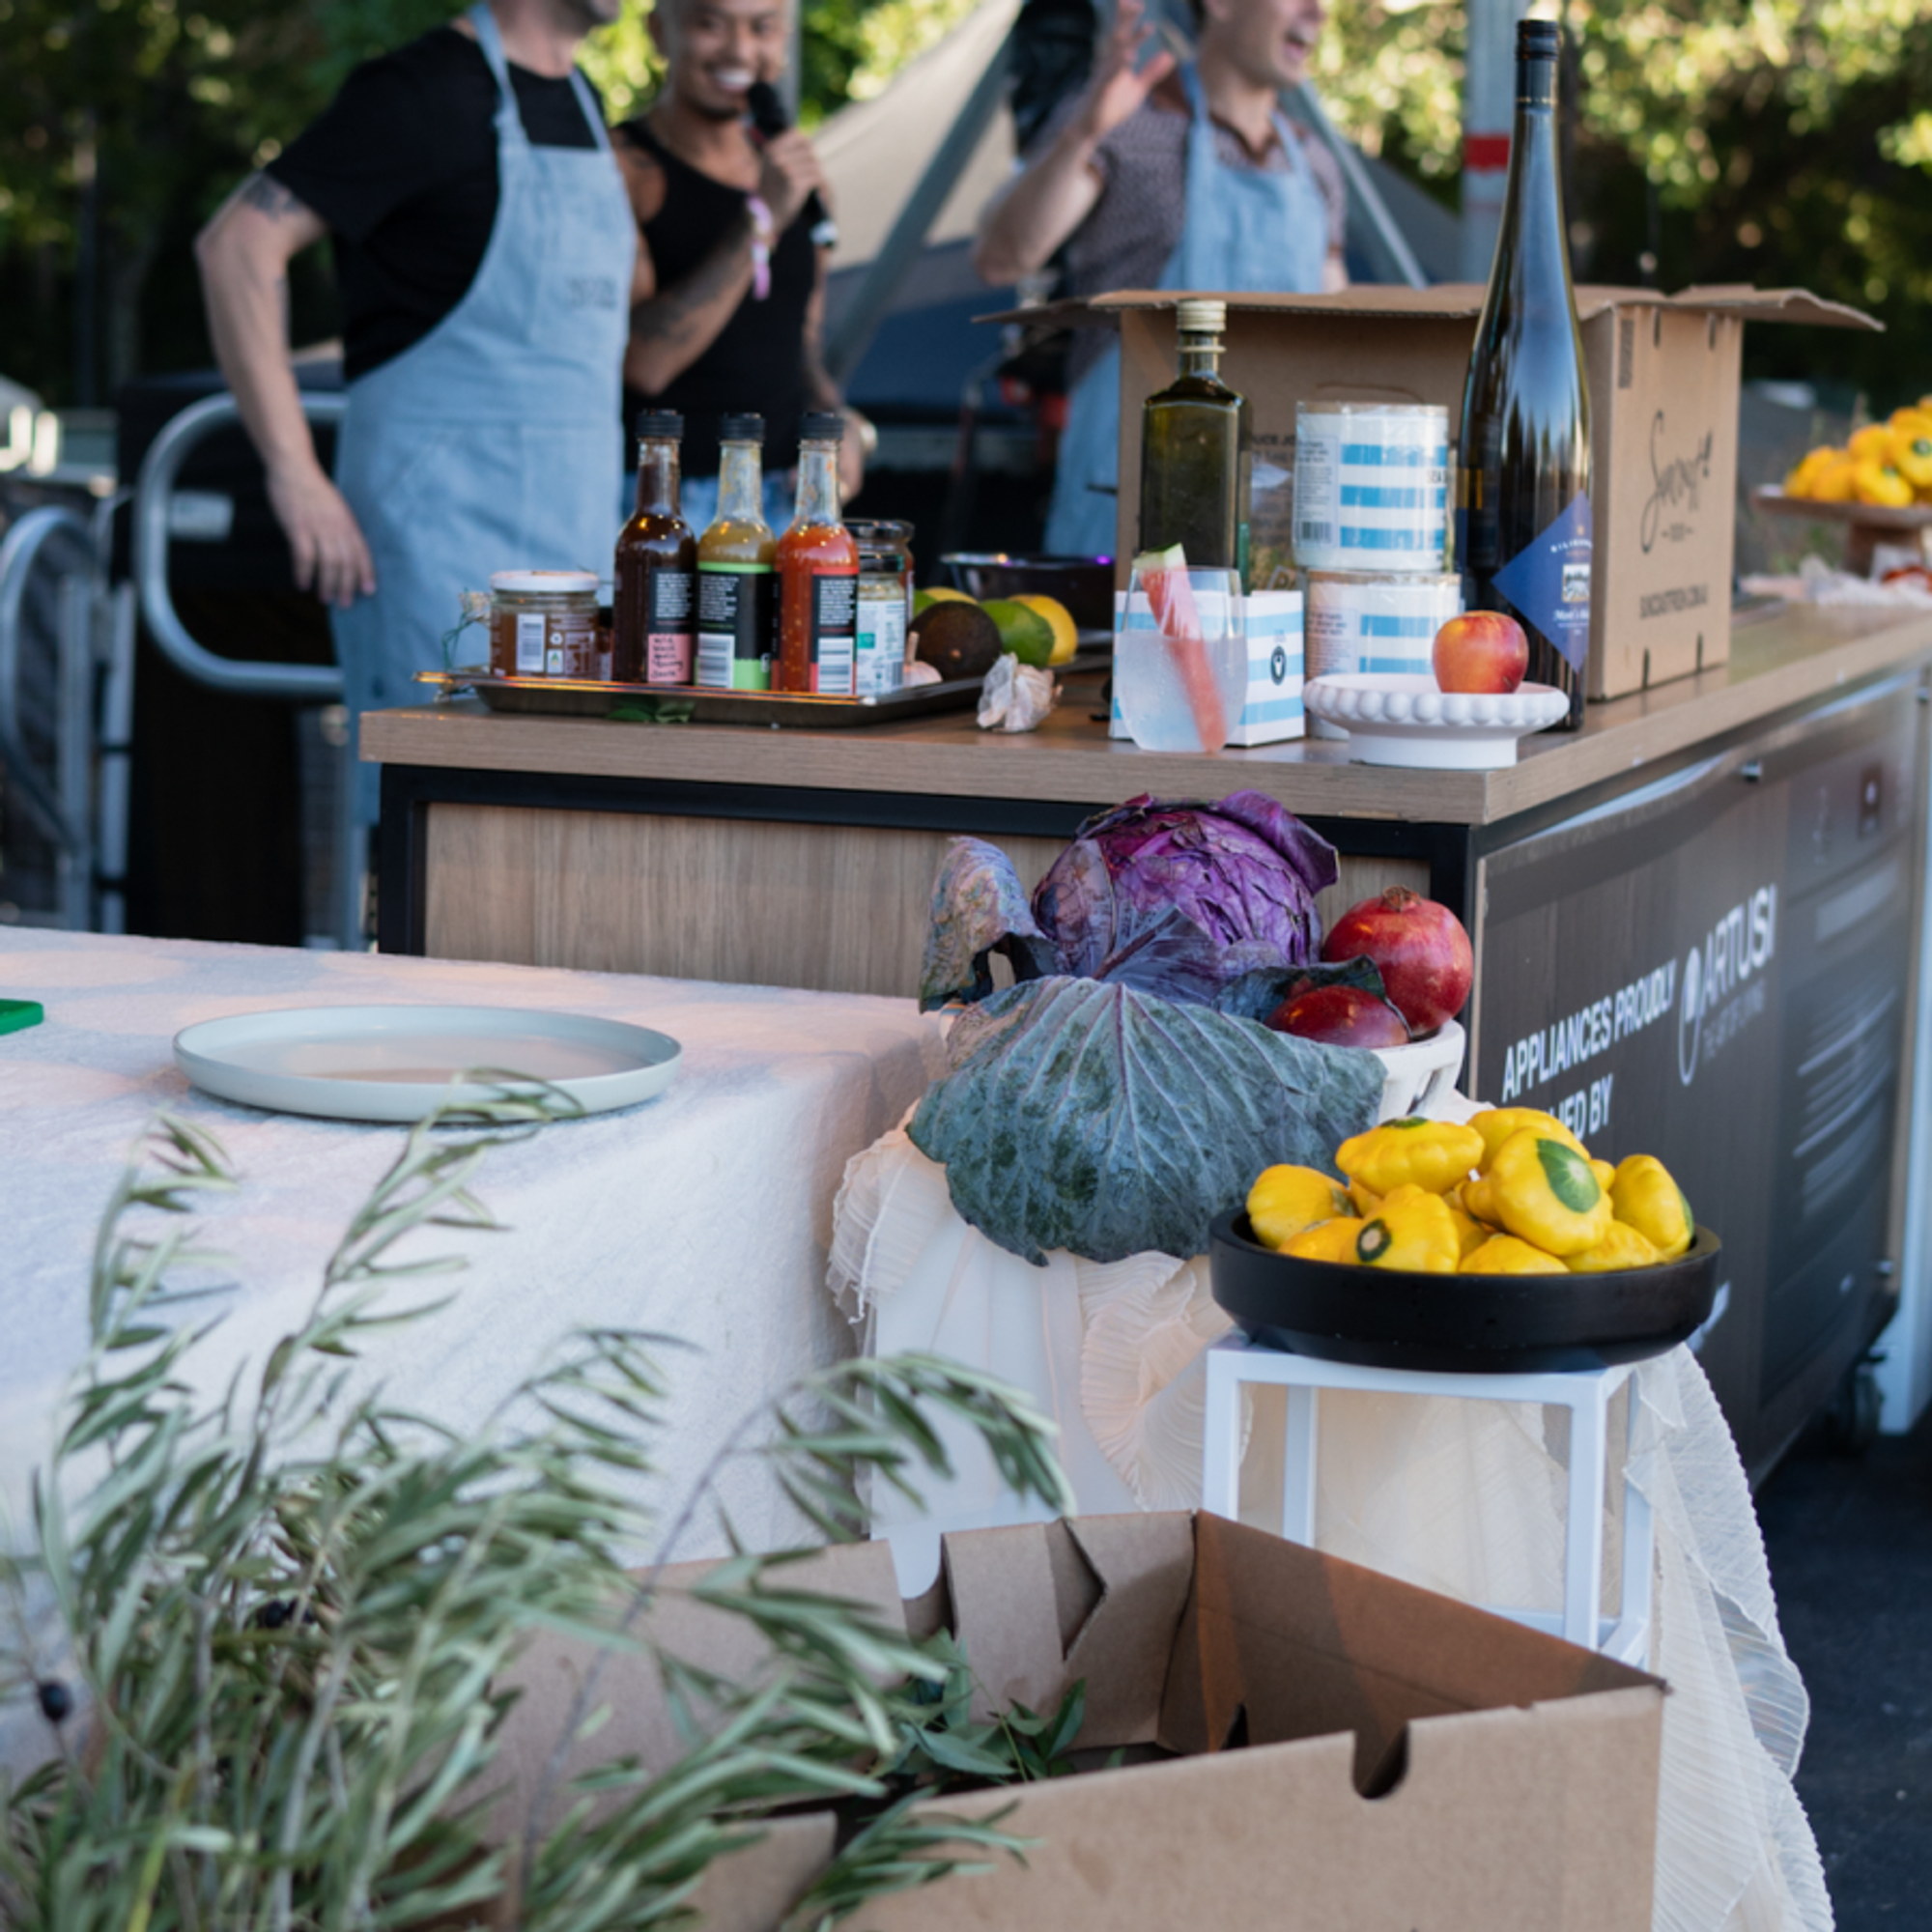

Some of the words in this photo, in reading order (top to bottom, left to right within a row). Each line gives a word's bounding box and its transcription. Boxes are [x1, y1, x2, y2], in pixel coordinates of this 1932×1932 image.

[1700, 883, 1776, 1019] ARTUSI
[1501, 996, 1612, 1103] APPLIANCES
[1614, 958, 1677, 1042] PROUDLY
[1589, 1073, 1613, 1135] BY
